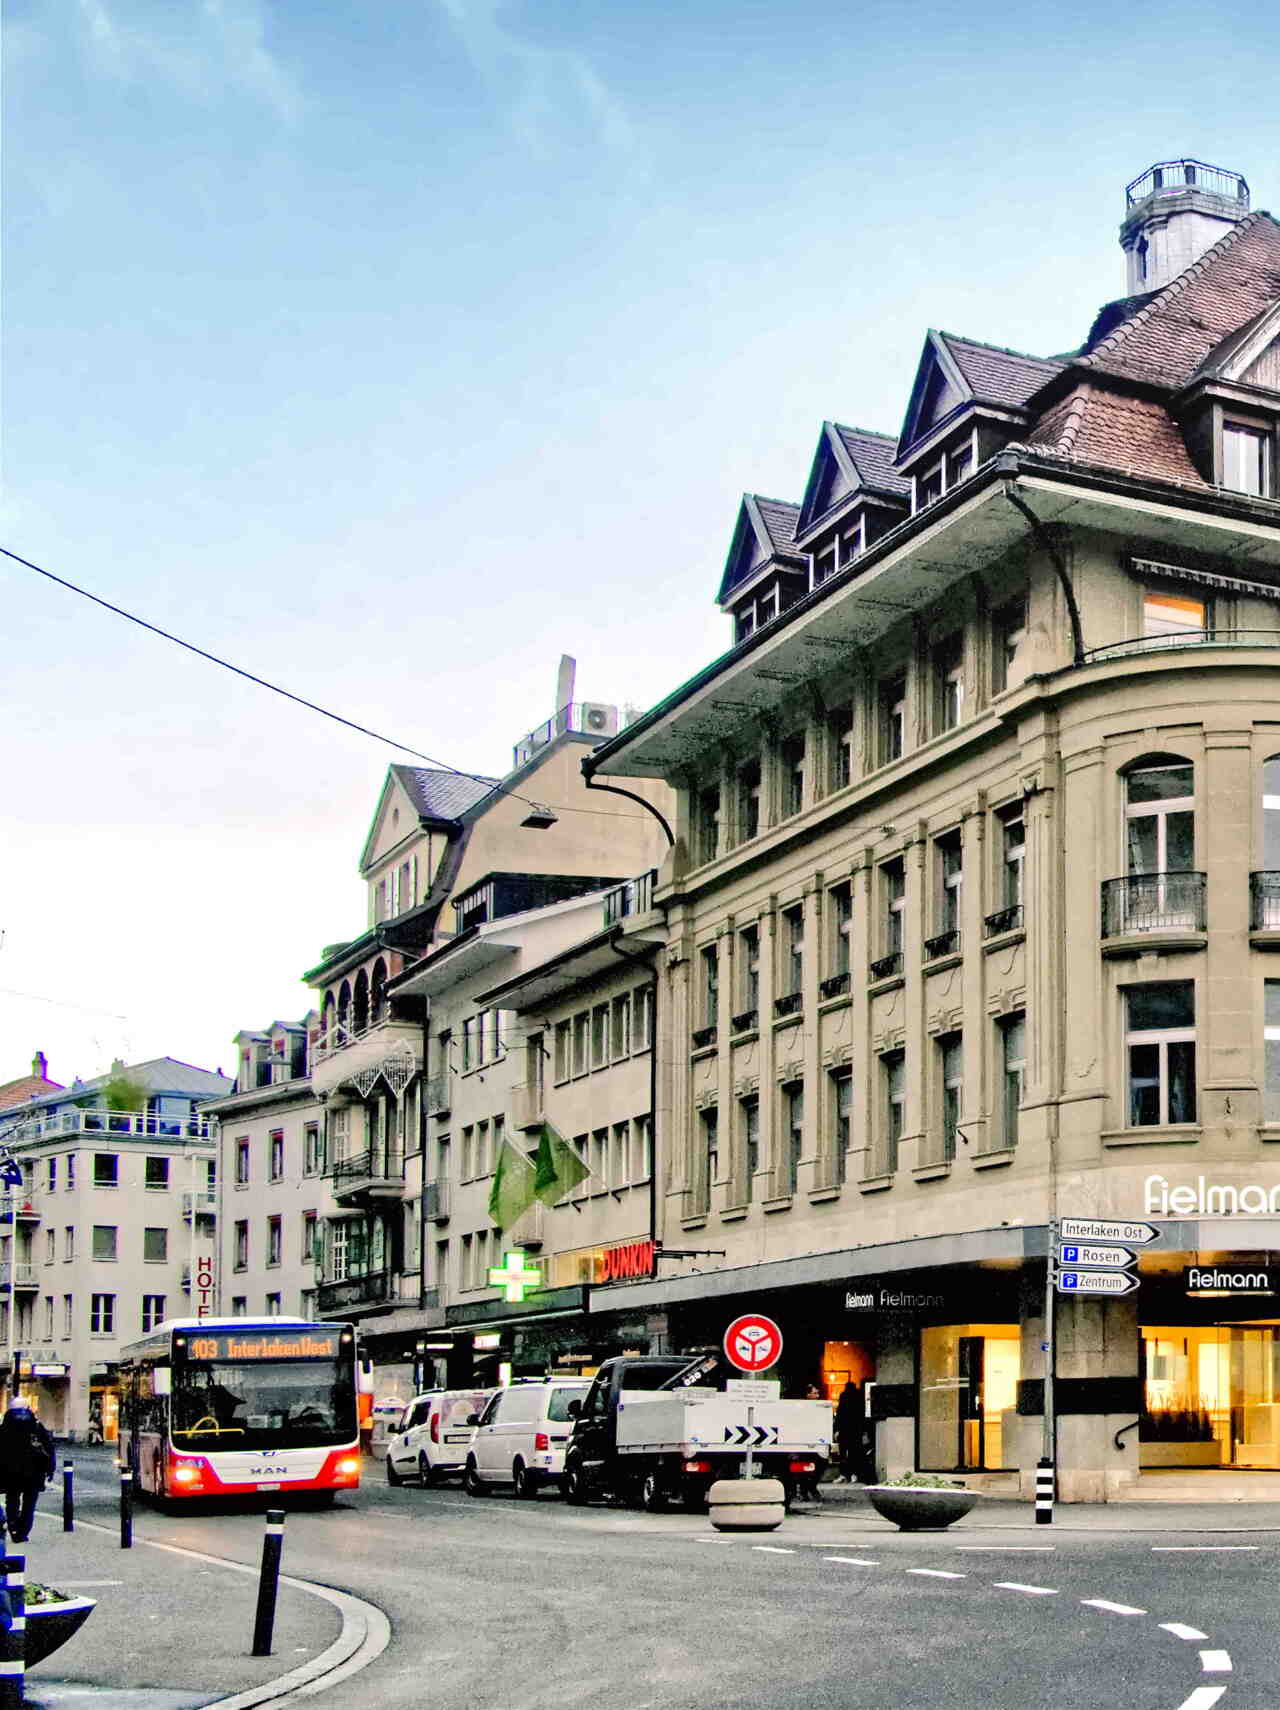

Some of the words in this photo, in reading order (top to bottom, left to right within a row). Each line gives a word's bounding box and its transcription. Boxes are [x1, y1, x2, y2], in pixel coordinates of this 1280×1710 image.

[1066, 1223, 1120, 1238] Interlaken
[1124, 1226, 1142, 1239] Ost
[1067, 1249, 1076, 1260] P
[1083, 1249, 1120, 1263] Rosen
[197, 1256, 212, 1318] HOTE
[1080, 1275, 1122, 1288] Zentrum
[1188, 1269, 1268, 1288] fielmann
[880, 1289, 945, 1306] fielmann
[191, 1339, 218, 1358] 103
